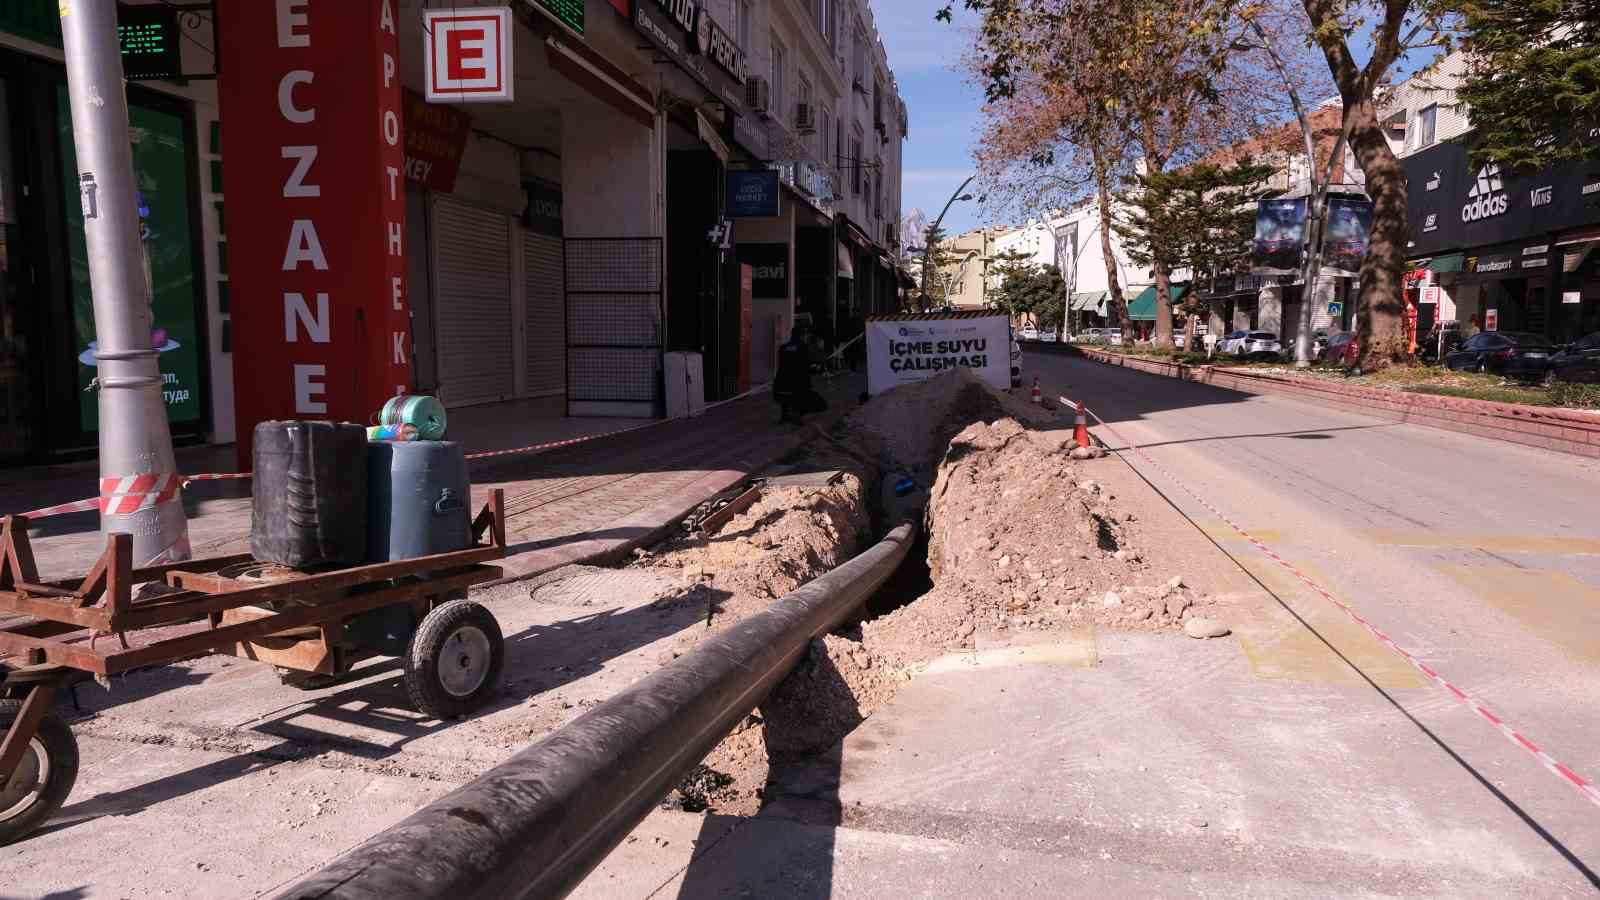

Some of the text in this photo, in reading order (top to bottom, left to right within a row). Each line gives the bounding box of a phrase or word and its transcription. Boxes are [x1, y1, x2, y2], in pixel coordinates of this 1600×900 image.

[447, 29, 486, 80] E
[275, 0, 330, 413] ECZANE
[380, 0, 407, 396] APOTHEK
[1462, 193, 1508, 223] adidas
[889, 338, 986, 357] İÇME SUYU
[889, 354, 988, 373] ÇALIŞMASI
